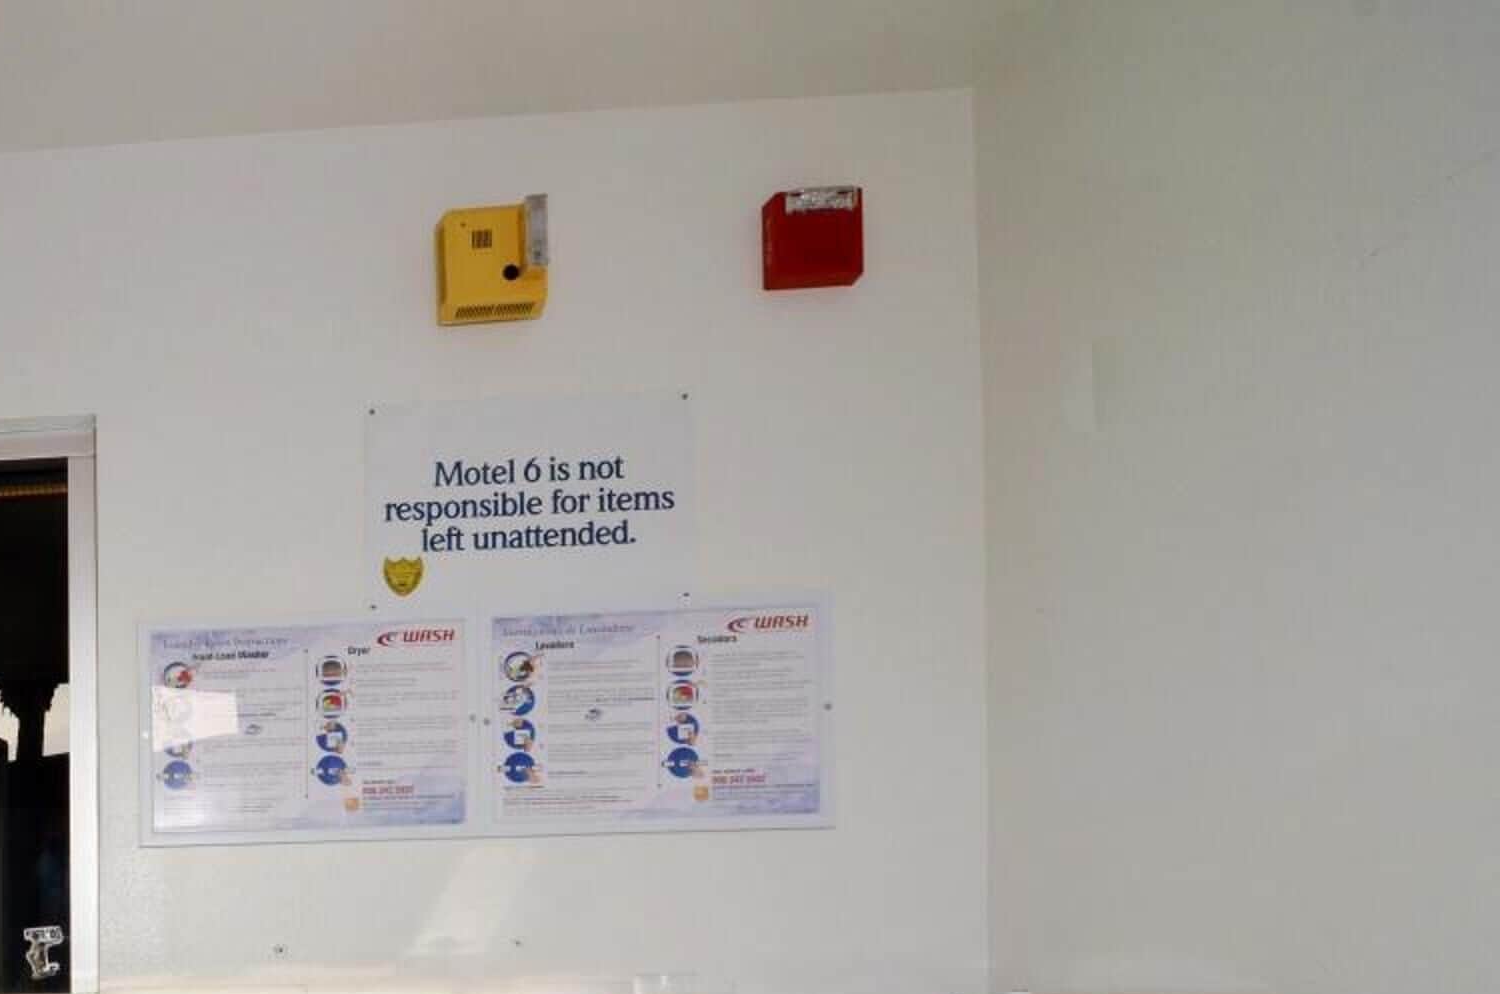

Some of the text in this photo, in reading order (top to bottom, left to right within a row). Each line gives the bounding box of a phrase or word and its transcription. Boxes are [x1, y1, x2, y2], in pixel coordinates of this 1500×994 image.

[434, 456, 624, 487] Motel 6 is not
[385, 488, 675, 526] responsible for items
[422, 519, 636, 551] left unattended.
[402, 629, 455, 643] WASH
[755, 615, 809, 629] WASH
